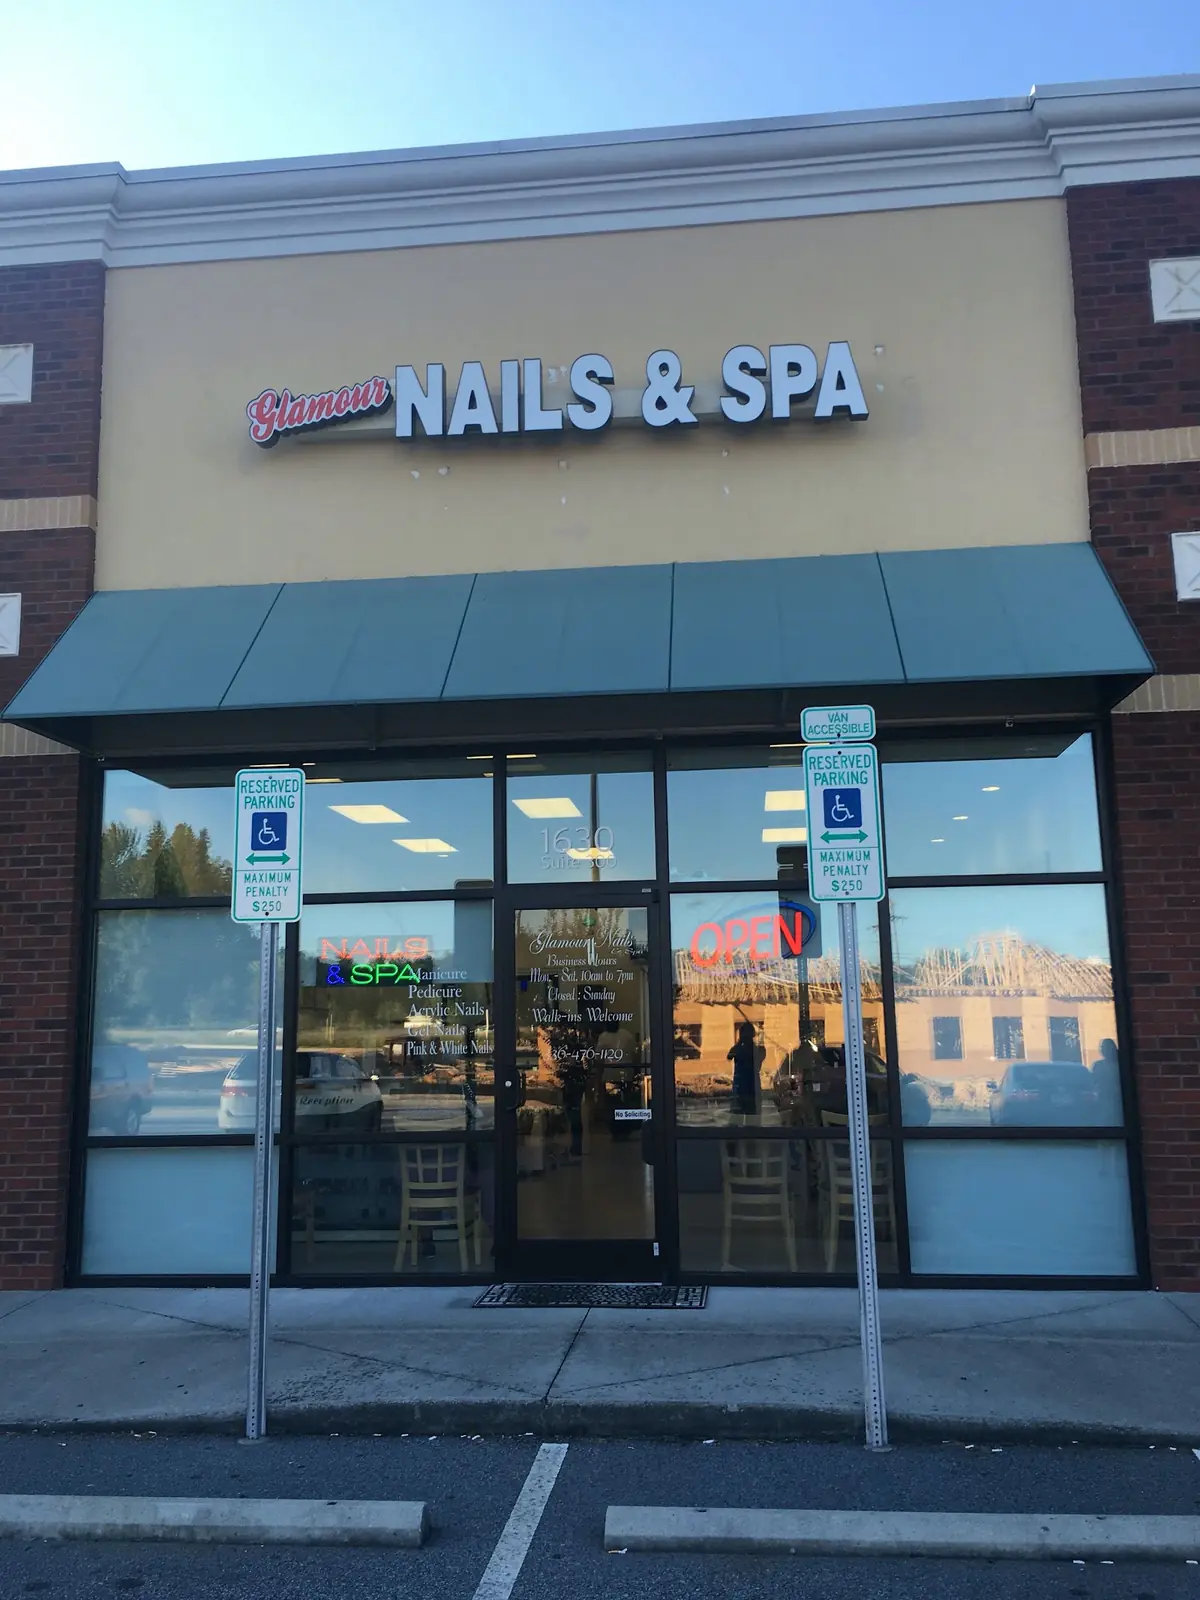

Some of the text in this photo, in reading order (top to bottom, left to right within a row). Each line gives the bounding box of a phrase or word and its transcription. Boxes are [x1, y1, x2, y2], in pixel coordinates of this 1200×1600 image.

[246, 341, 869, 443] Glamour NAILS & SPA
[828, 712, 849, 723] VAN
[807, 722, 870, 735] ACCESSIBLE
[809, 754, 871, 770] RESERVED
[814, 770, 868, 786] PARKING
[241, 779, 299, 794] RESERVED
[244, 795, 295, 810] PARKING
[541, 826, 615, 854] 1630
[541, 855, 580, 869] Suite
[820, 850, 871, 862] MAXIMUM
[244, 871, 292, 883] MAXIMUM
[823, 864, 869, 877] PENALTY
[246, 886, 289, 898] PENALTY
[831, 879, 863, 892] $250
[252, 900, 282, 912] $250
[529, 928, 634, 955] Glamour Nails
[690, 911, 803, 968] OPEN
[319, 937, 429, 960] NAILS
[547, 954, 586, 967] Business
[326, 963, 421, 985] & SPA
[408, 966, 467, 981] Manicure
[581, 970, 603, 981] 10am
[605, 970, 614, 981] to
[616, 969, 634, 984] 7pm
[408, 984, 463, 999] Pedicure
[548, 986, 575, 1001] Closed
[583, 986, 616, 1004] Sunday
[408, 1001, 485, 1018] Acrylic Nails
[532, 1007, 633, 1023] Walk-ins Welcome
[435, 1023, 465, 1037] Nails
[407, 1040, 494, 1056] Pink & White Nails
[546, 1045, 624, 1062] 36-476-1129
[615, 1110, 651, 1119] No Soliciting
